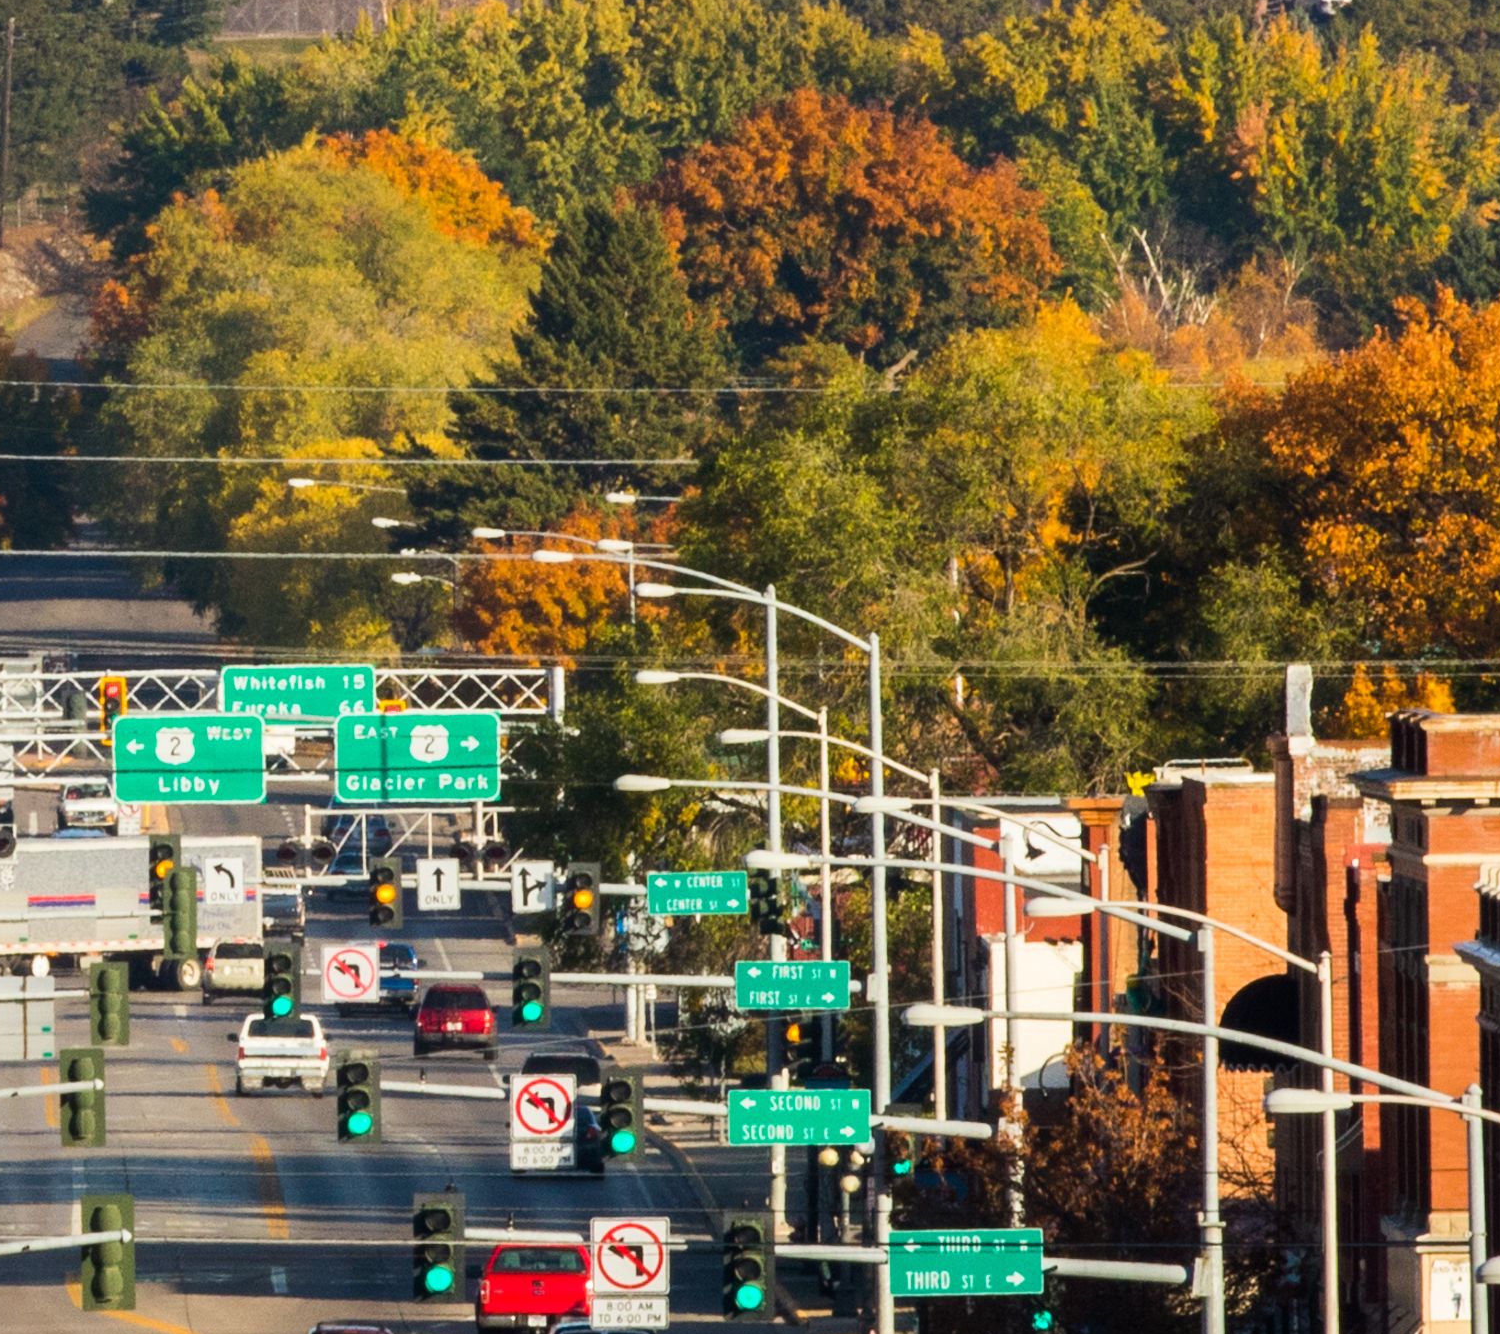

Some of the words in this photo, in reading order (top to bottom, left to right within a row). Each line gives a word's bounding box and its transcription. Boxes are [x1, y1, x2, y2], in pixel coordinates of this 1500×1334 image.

[233, 675, 326, 691] Whitefish
[342, 674, 366, 690] 15
[338, 700, 366, 715] 66
[206, 726, 254, 741] WEST
[353, 725, 399, 740] EAST
[169, 736, 182, 758] 2
[423, 734, 436, 756] 2
[158, 774, 220, 795] Libby
[345, 774, 426, 792] Glacier
[438, 773, 489, 791] Park
[686, 875, 724, 888] CENTER
[210, 891, 240, 902] ONLY
[424, 894, 455, 905] ONLY
[666, 898, 703, 911] CENTER
[771, 965, 804, 980] FIRST
[811, 968, 822, 978] ST
[749, 990, 781, 1005] FIRST
[769, 1095, 822, 1112] SECOND
[830, 1098, 843, 1110] ST
[851, 1098, 860, 1110] W
[741, 1124, 794, 1141] SECOND
[803, 1127, 816, 1140] ST
[823, 1128, 830, 1140] E
[937, 1235, 982, 1253] THIRD
[905, 1270, 950, 1291] THIRD
[961, 1274, 975, 1289] ST
[985, 1274, 992, 1289] E
[606, 1301, 632, 1311] 8:00
[638, 1301, 653, 1311] AM
[598, 1314, 612, 1324] TO
[616, 1314, 642, 1324] 6:00
[647, 1314, 662, 1323] PM
